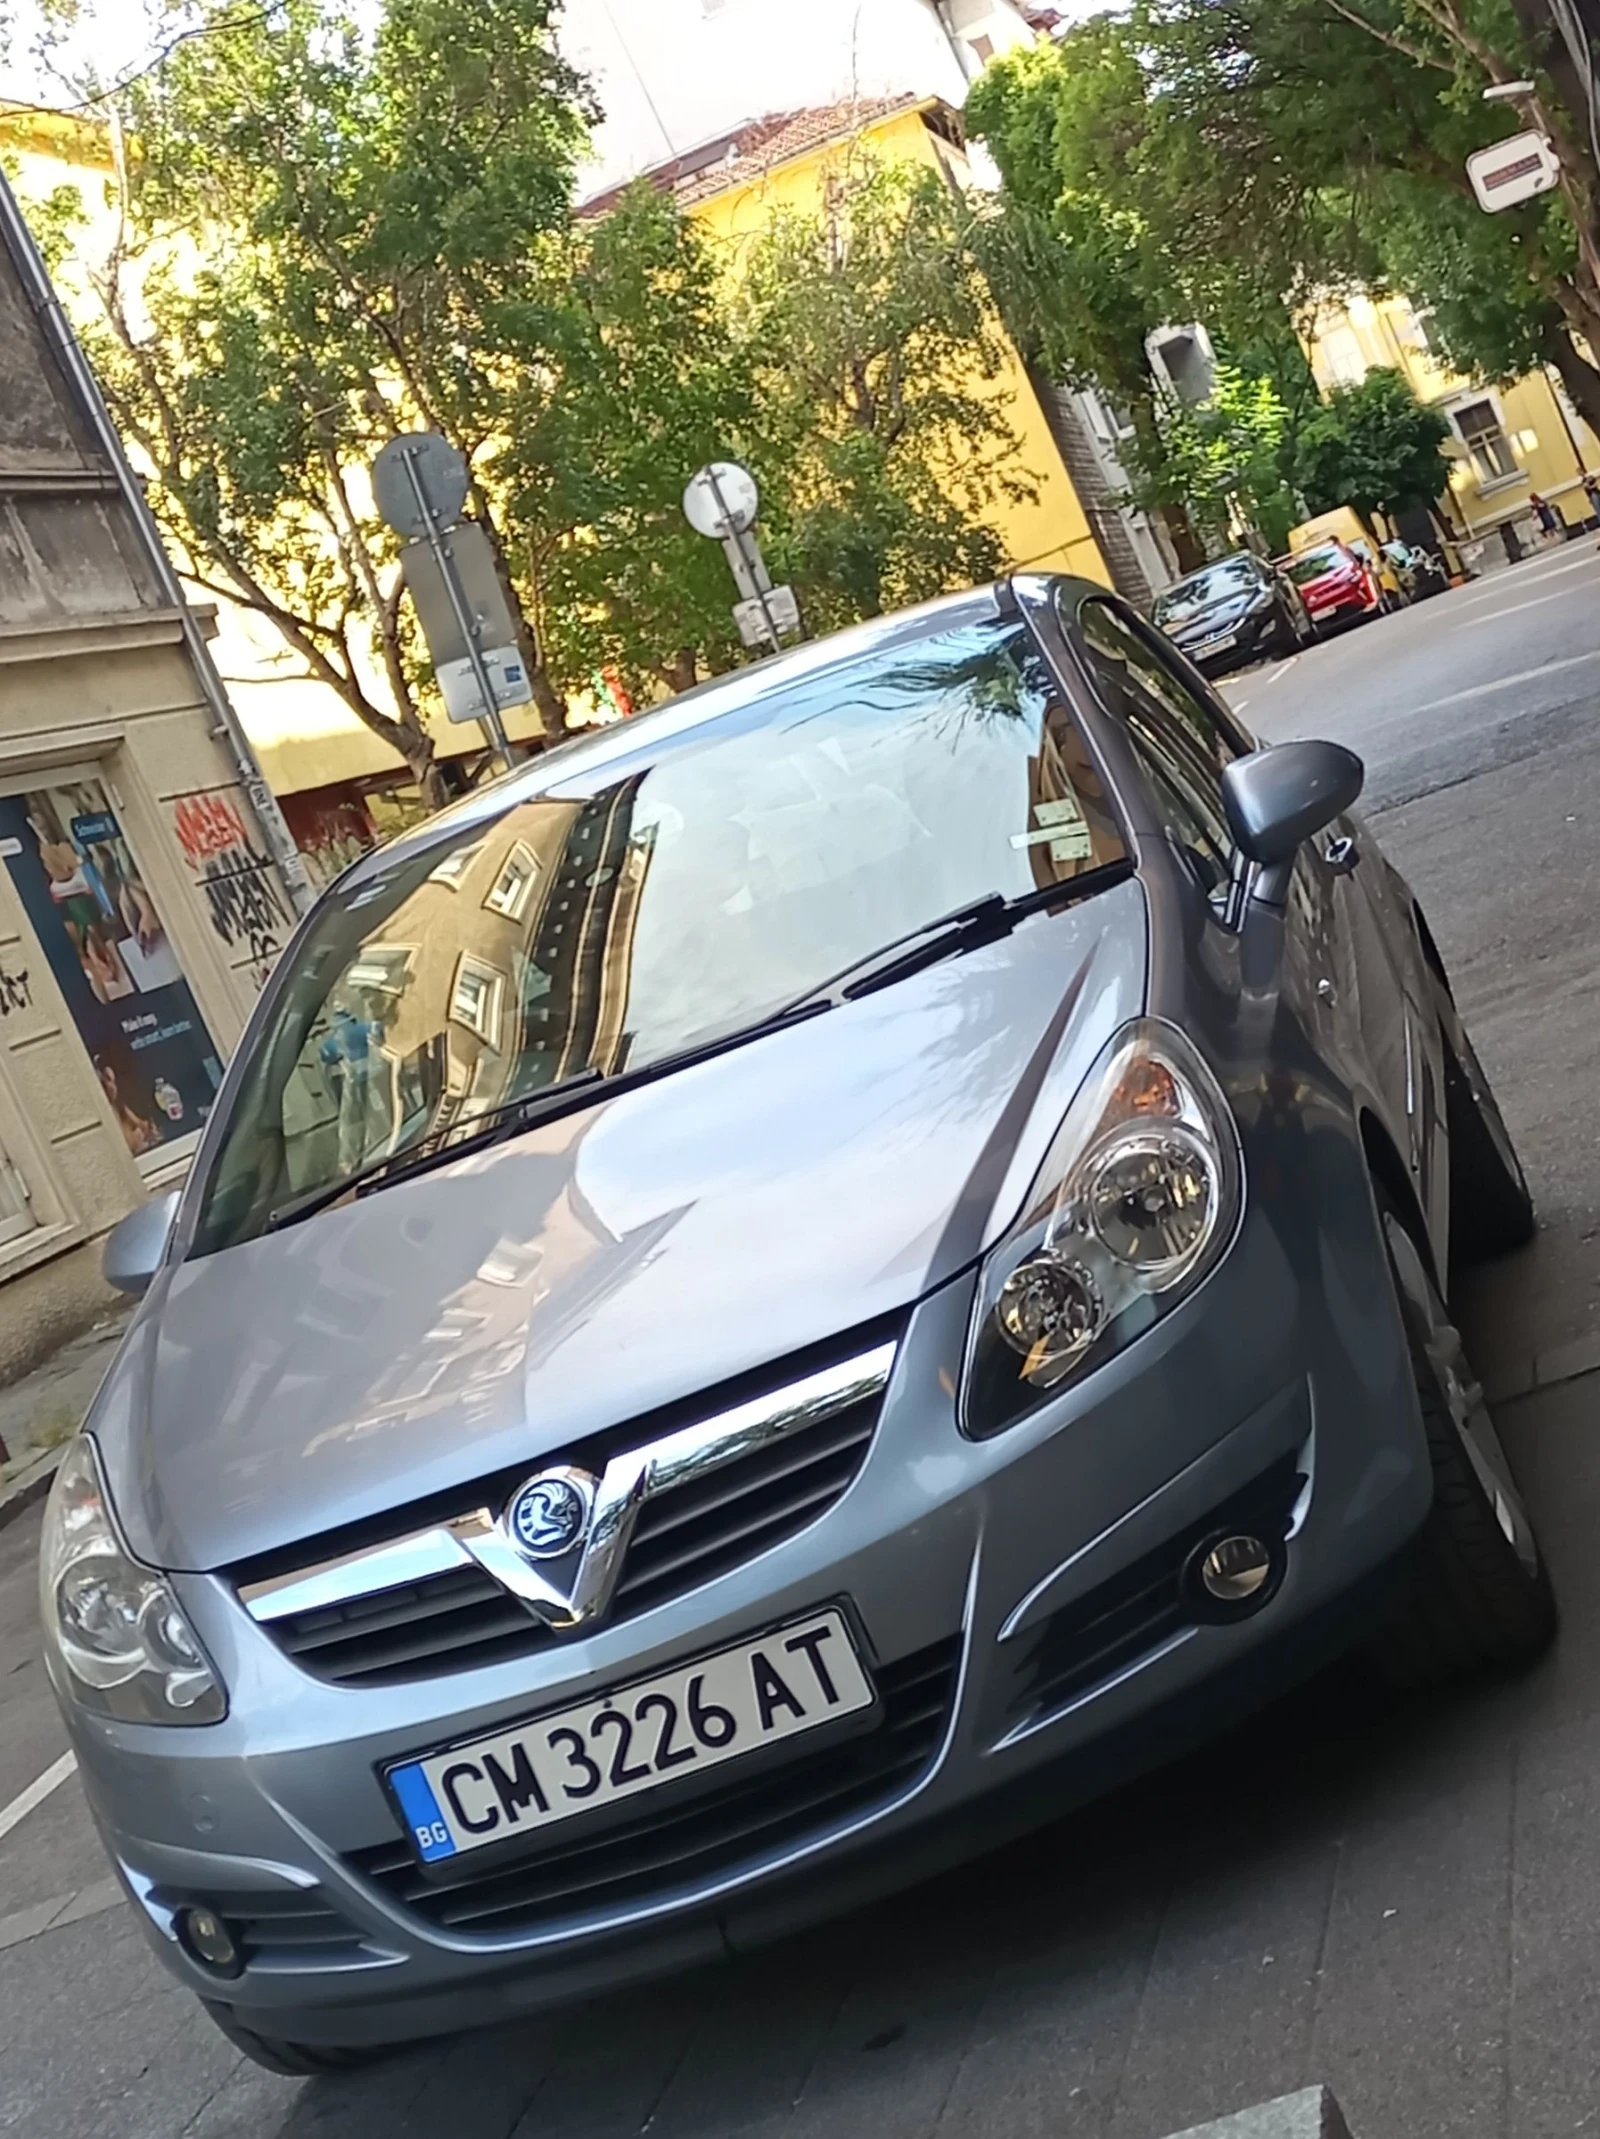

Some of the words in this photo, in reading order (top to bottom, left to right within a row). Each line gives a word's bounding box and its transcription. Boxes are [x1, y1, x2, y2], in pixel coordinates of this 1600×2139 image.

[441, 1742, 551, 1835] CM
[547, 1675, 737, 1799] 3226
[748, 1626, 841, 1731] AT
[415, 1820, 448, 1849] BG
